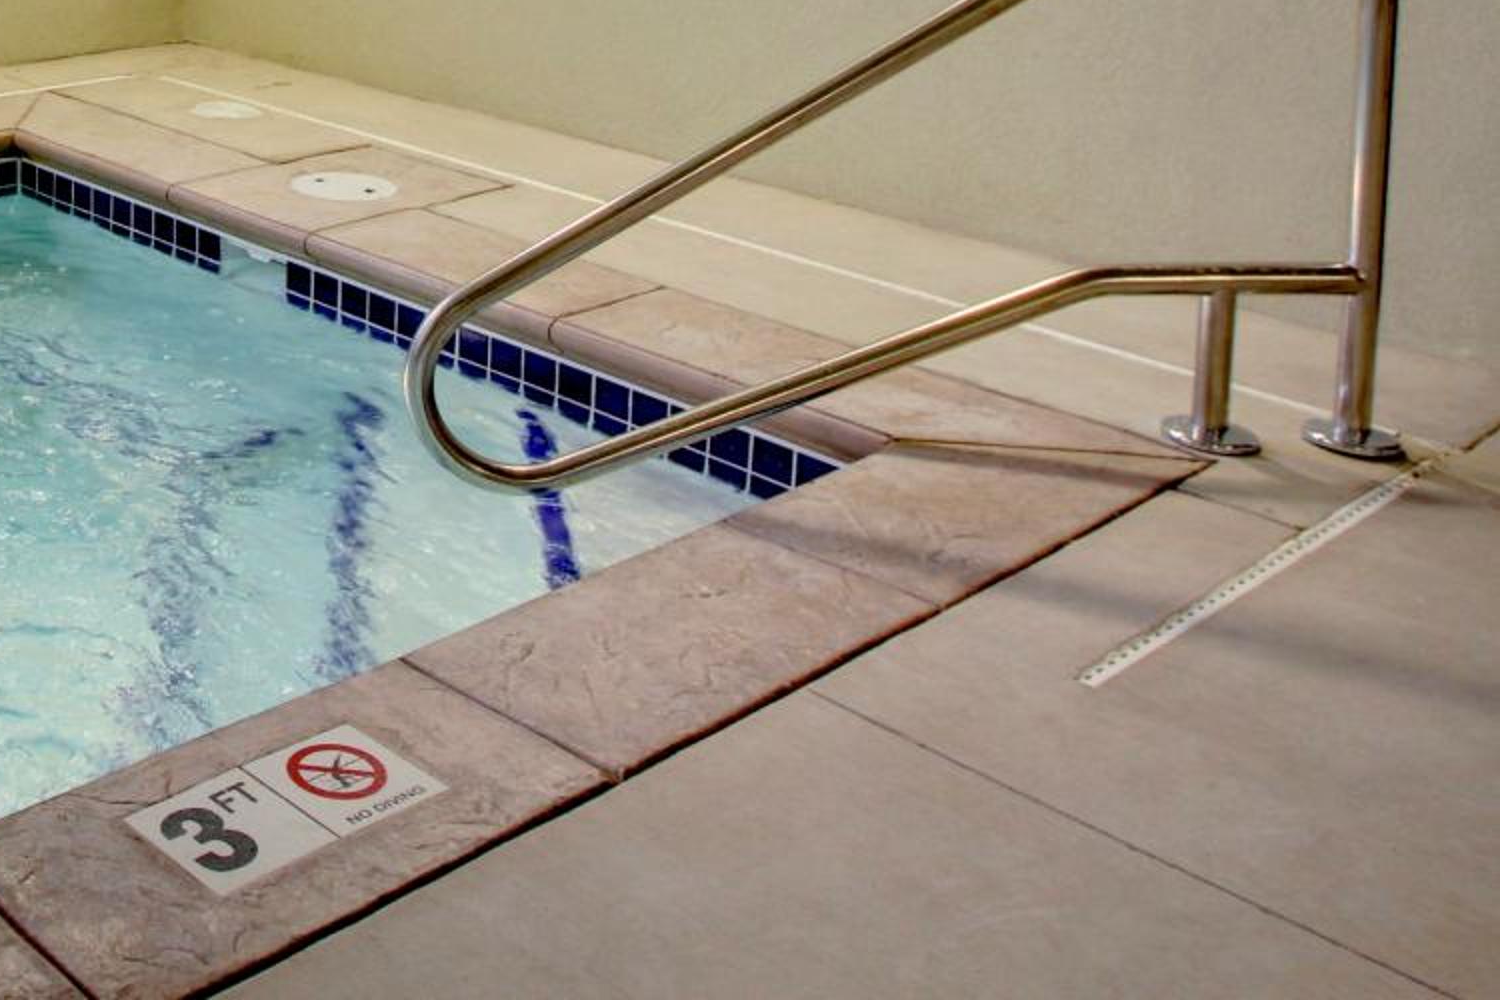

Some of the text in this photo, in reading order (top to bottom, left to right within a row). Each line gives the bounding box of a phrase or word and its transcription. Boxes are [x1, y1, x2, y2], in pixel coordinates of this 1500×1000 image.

[160, 781, 258, 872] 3 FT
[345, 784, 426, 825] NO DIVING
